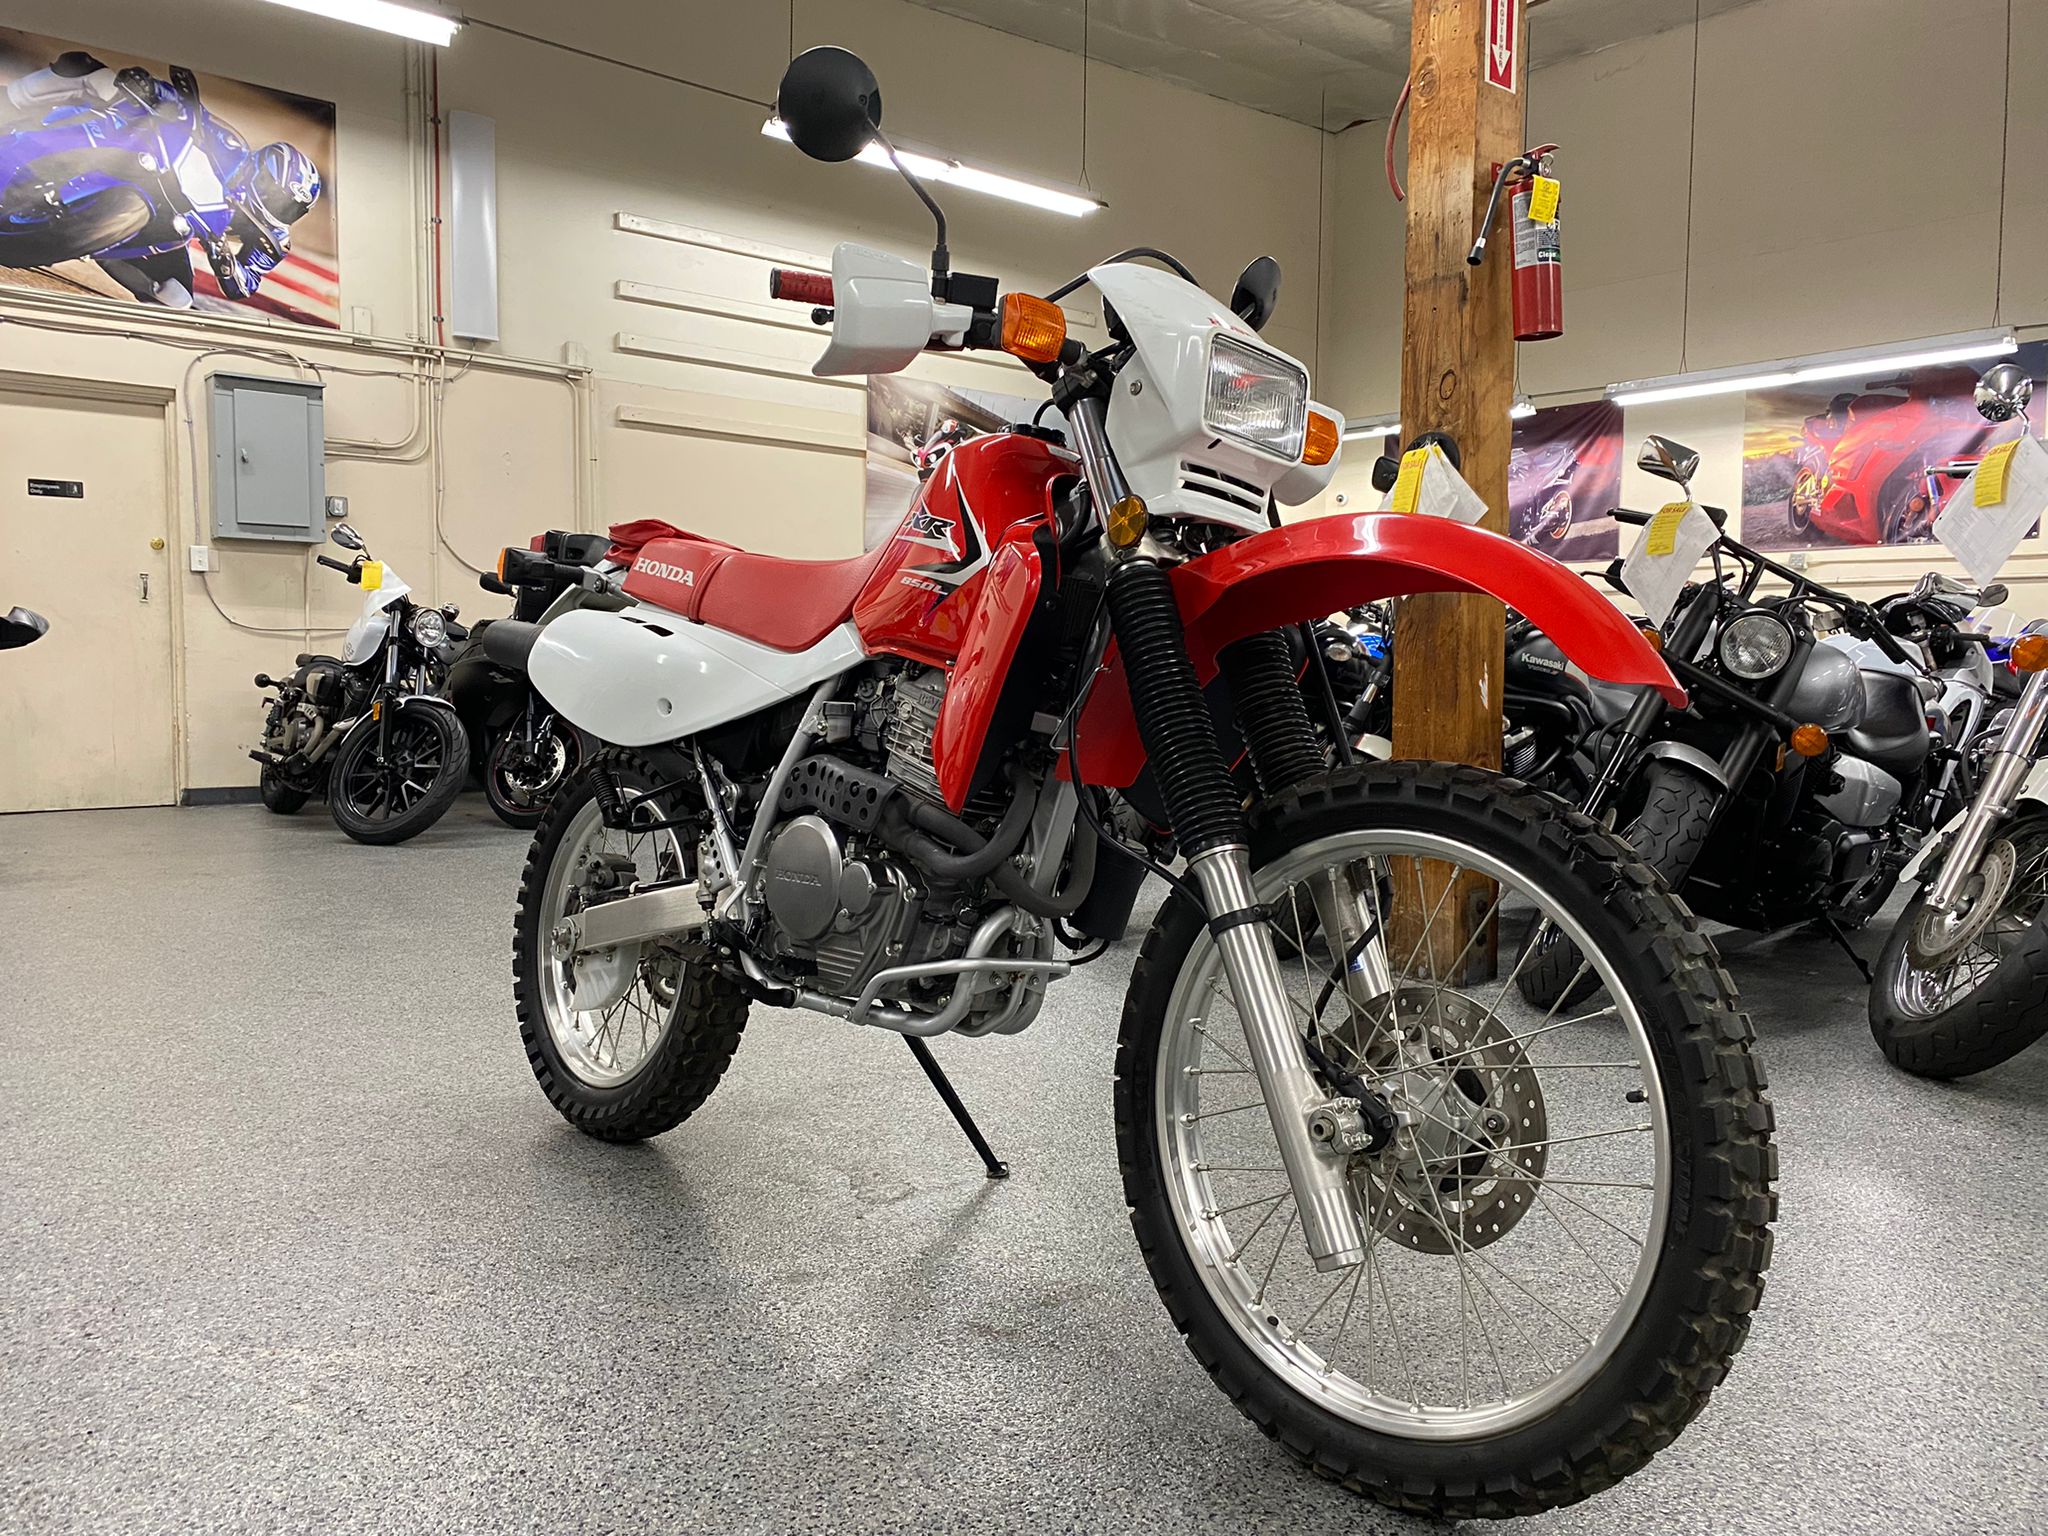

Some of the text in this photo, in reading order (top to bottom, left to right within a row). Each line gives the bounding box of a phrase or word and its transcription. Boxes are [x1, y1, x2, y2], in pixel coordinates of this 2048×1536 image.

[902, 512, 956, 540] XR
[633, 557, 694, 587] HONDA
[1521, 652, 1565, 671] Kawasaki
[775, 868, 822, 887] HONDA
